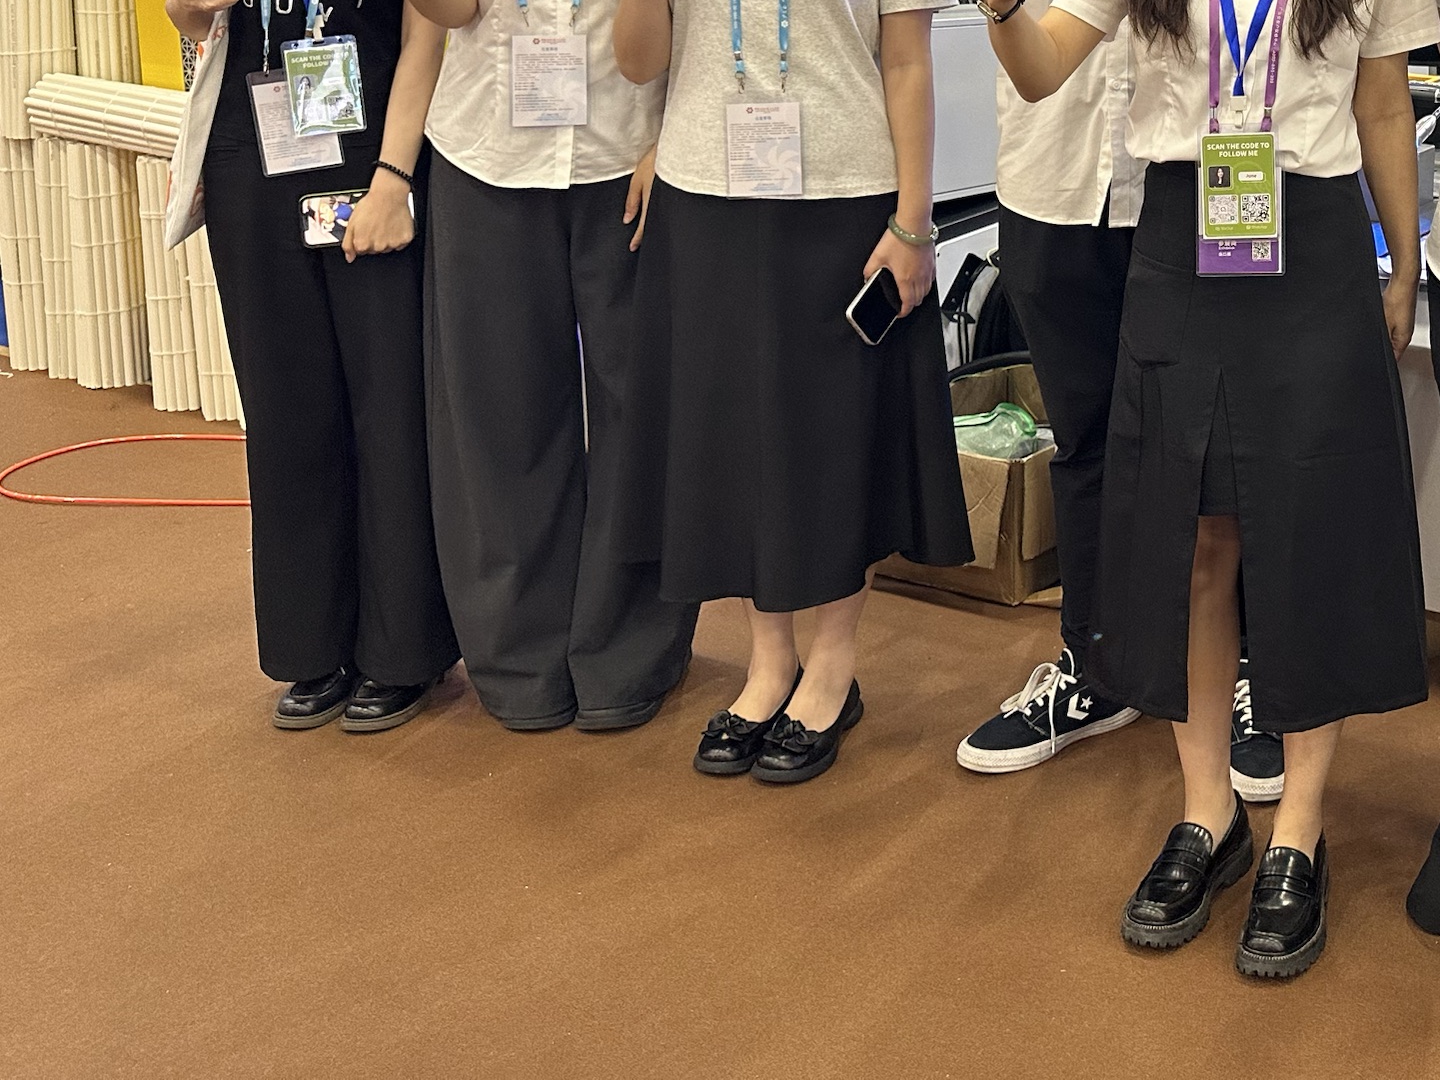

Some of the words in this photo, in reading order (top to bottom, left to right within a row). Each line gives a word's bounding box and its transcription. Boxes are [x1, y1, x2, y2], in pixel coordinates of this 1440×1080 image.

[291, 56, 308, 64] SCAN
[303, 61, 329, 69] FOLLOW
[1207, 143, 1226, 151] SCAN
[1240, 142, 1259, 150] CODE
[1219, 150, 1248, 158] FOLLOW
